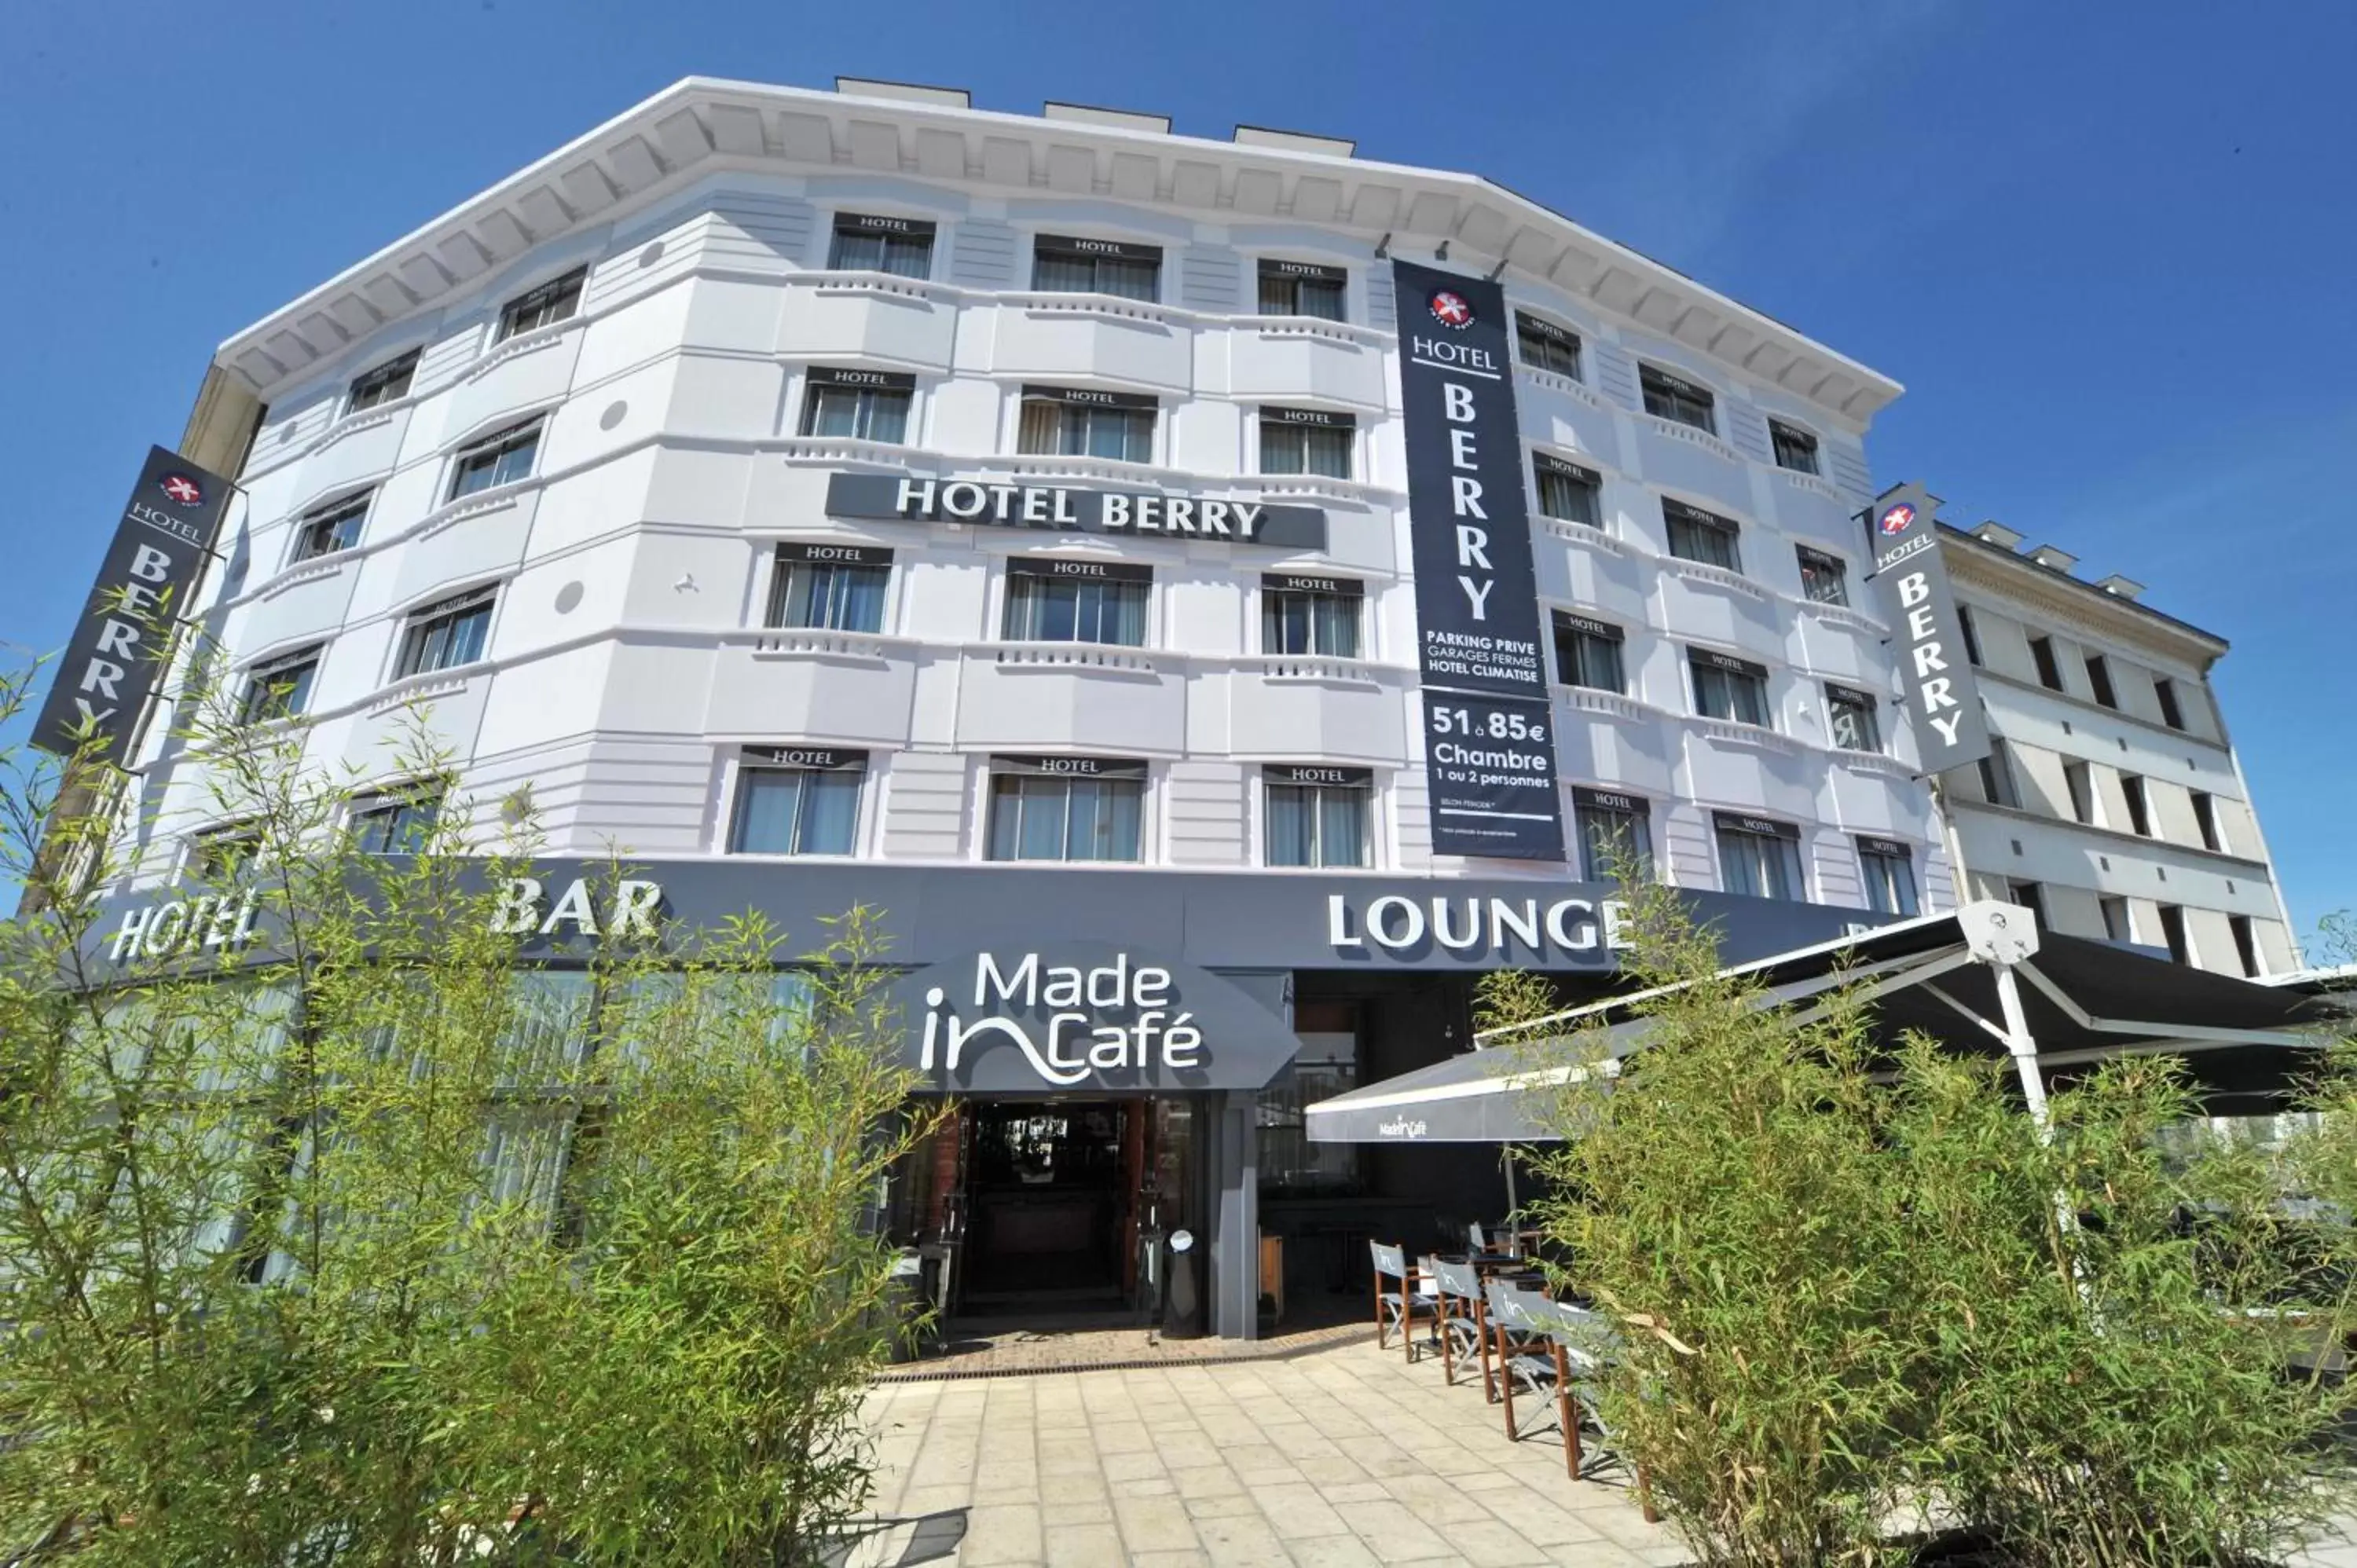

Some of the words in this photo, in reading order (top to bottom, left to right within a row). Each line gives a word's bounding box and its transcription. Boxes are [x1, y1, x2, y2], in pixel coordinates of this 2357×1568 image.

[861, 218, 908, 232] HOTEL
[1076, 240, 1122, 253] HOTEL
[1281, 262, 1322, 275] HOTEL
[1413, 335, 1497, 370] HOTEL
[835, 371, 887, 384] HOTEL
[1066, 390, 1116, 403] HOTEL
[1285, 411, 1331, 424] HOTEL
[896, 478, 1076, 524] HOTEL
[1102, 493, 1263, 537] BERRY
[1444, 382, 1494, 621] BERRY
[133, 502, 201, 542] HOTEL
[806, 546, 862, 560] HOTEL
[1878, 533, 1932, 568] HOTEL
[1054, 562, 1107, 575] HOTEL
[1288, 577, 1337, 591] HOTEL
[1571, 616, 1606, 633] HOTEL
[75, 543, 171, 738] BERRY
[1427, 631, 1492, 649] PARKING
[1496, 639, 1536, 654] PRIVE
[1428, 645, 1489, 662] GARAGES
[1898, 571, 1963, 747] BERRY
[1429, 660, 1469, 675] HOTEL
[1472, 665, 1538, 683] CLIMATISE
[1433, 706, 1469, 735] 51
[1475, 724, 1484, 737] à
[773, 750, 835, 764] HOTEL
[1435, 742, 1547, 771] Chambre
[1041, 760, 1099, 772] HOTEL
[1292, 768, 1345, 781] HOTEL
[1437, 768, 1442, 780] 1
[1448, 771, 1465, 782] ou
[1468, 771, 1477, 783] 2
[1480, 774, 1550, 788] personnes
[1595, 792, 1633, 809] HOTEL
[1744, 819, 1774, 833] HOTEL
[489, 878, 661, 936] BAR
[1329, 895, 1637, 950] LOUNGE
[974, 952, 1170, 1006] Made
[920, 987, 1091, 1085] in
[1047, 1011, 1201, 1068] Café
